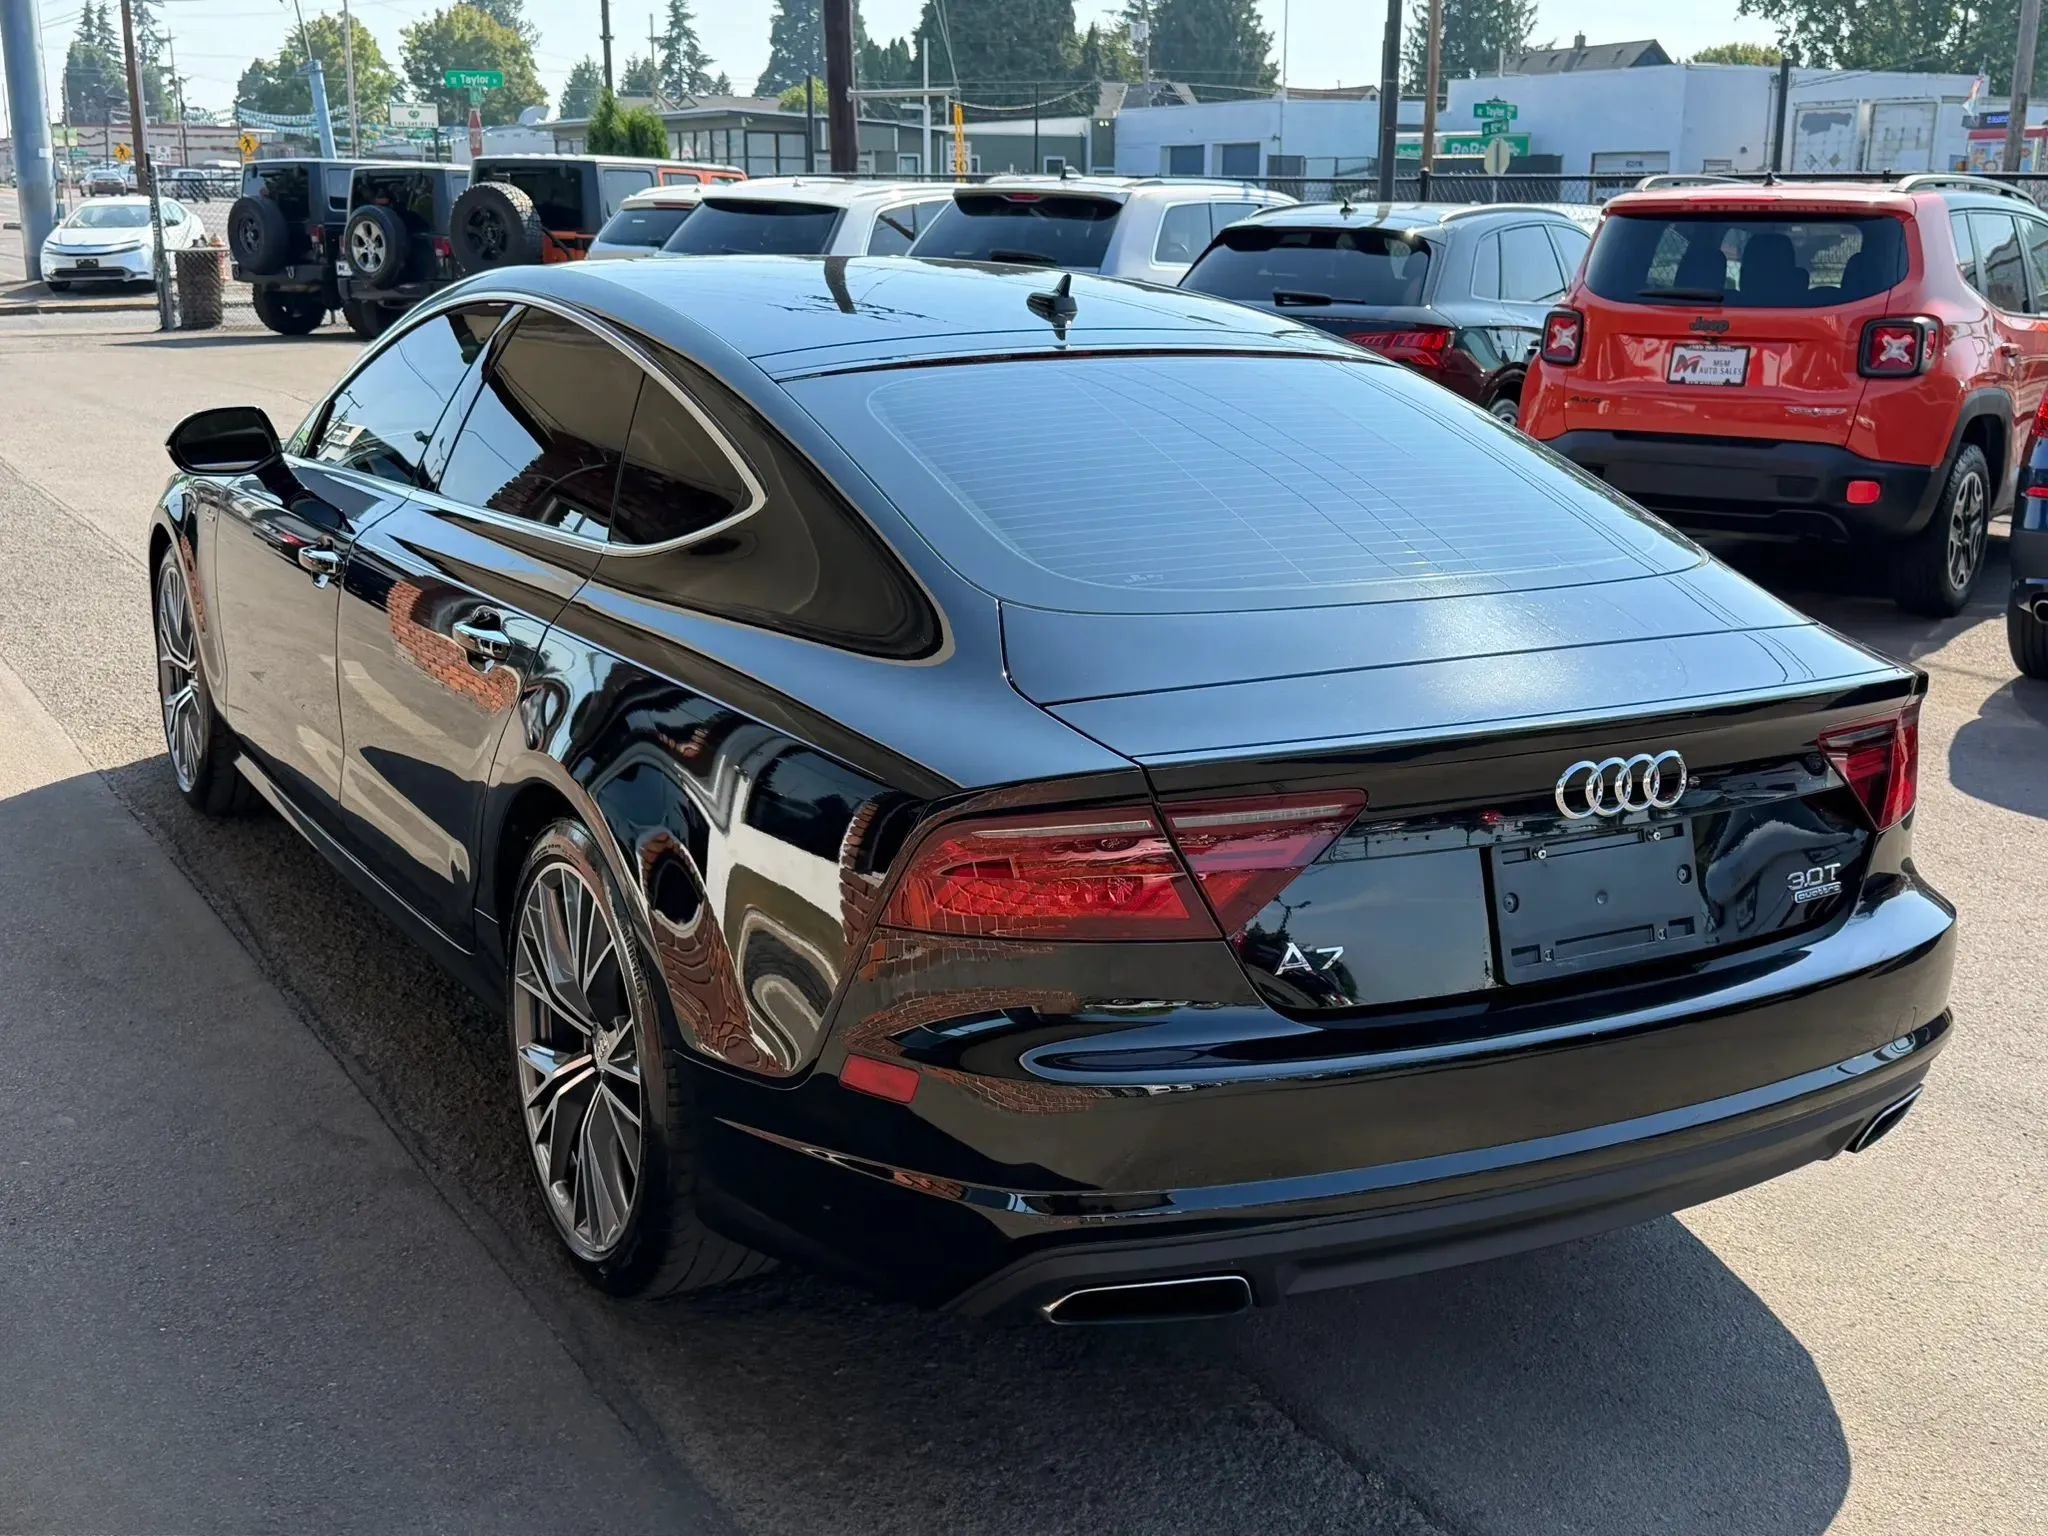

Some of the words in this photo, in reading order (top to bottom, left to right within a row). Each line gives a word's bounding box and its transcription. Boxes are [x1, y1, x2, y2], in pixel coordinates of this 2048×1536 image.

[460, 74, 489, 87] Taylor
[1690, 316, 1729, 333] Jeep
[1699, 367, 1718, 375] AUTO
[1719, 367, 1742, 375] SALES
[1797, 883, 1842, 901] quattro
[1274, 942, 1344, 976] A7
